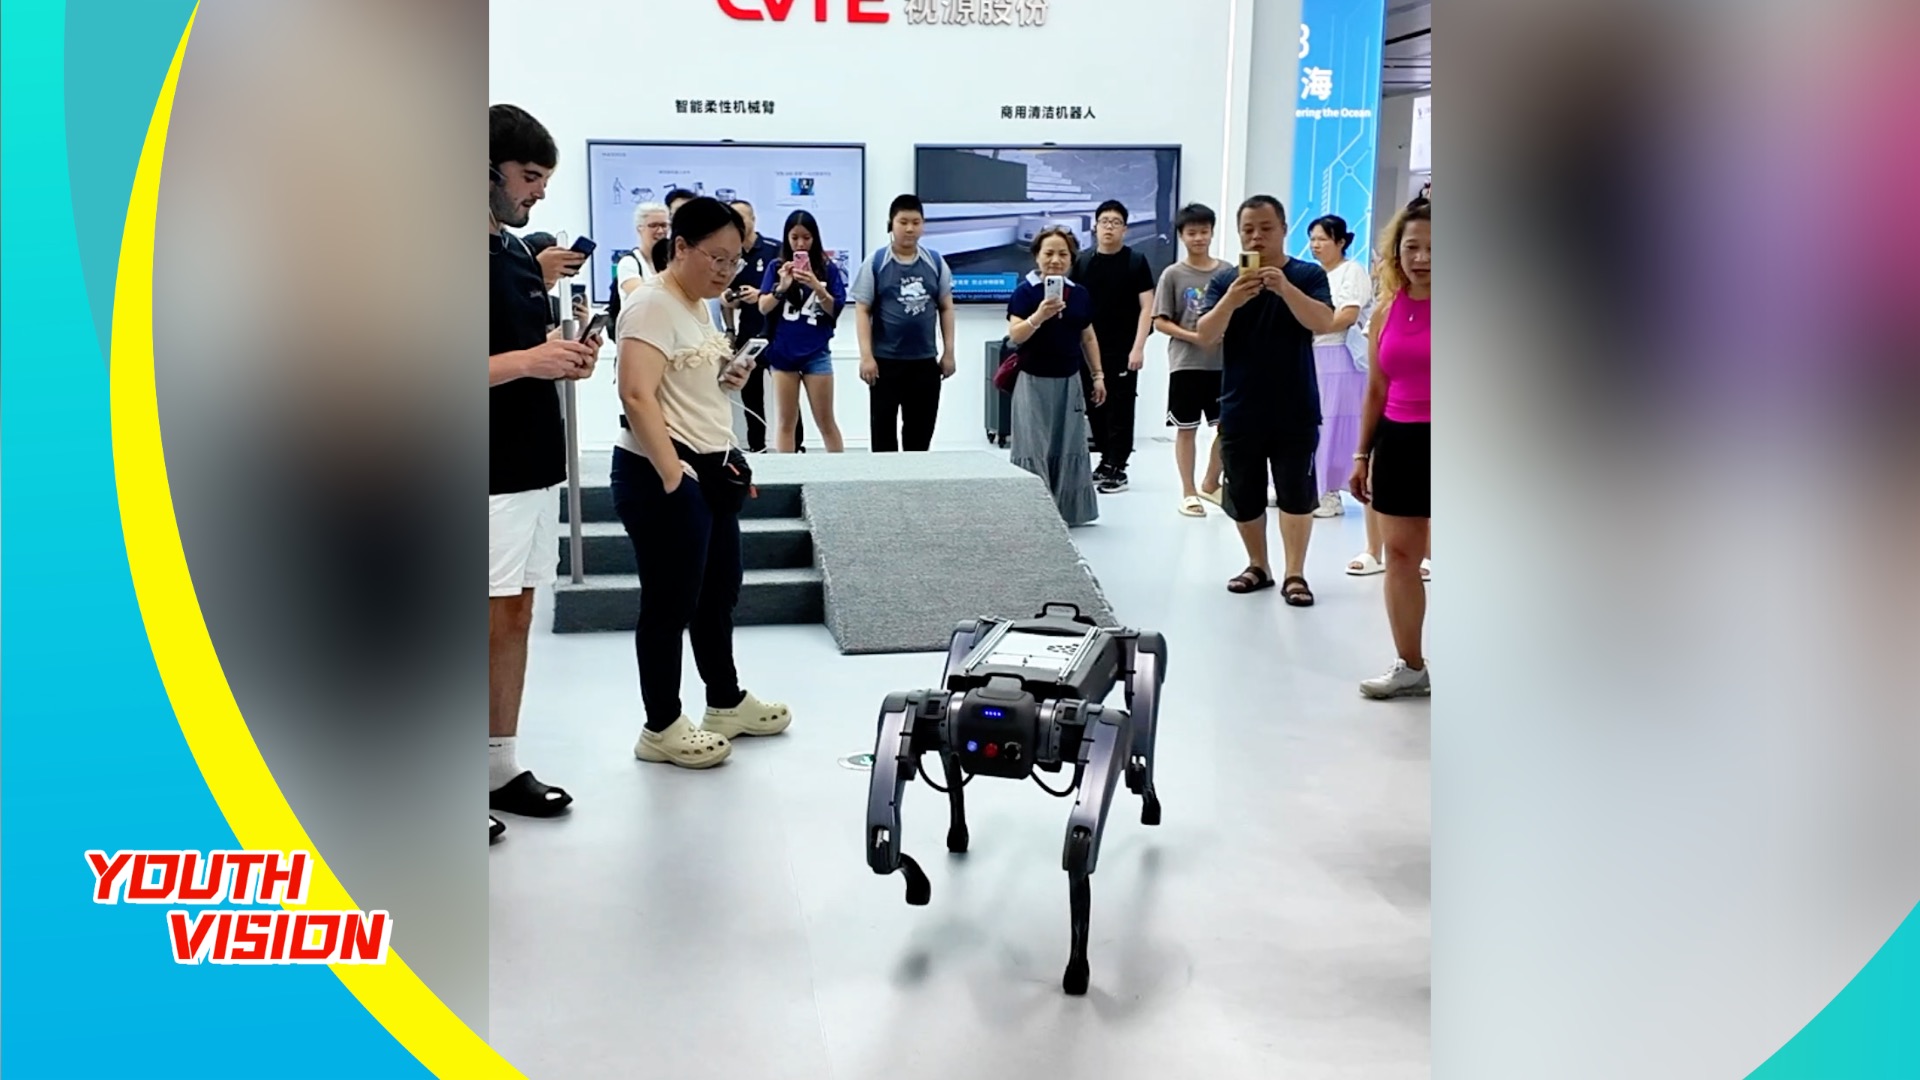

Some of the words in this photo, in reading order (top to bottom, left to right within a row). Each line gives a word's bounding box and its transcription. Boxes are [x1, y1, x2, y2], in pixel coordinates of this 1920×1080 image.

[1301, 66, 1333, 100] 海
[675, 99, 775, 114] 智能柔性机械臂
[1001, 105, 1097, 119] 商用清洁机器人
[1323, 107, 1339, 118] the
[1341, 107, 1372, 118] Ocean
